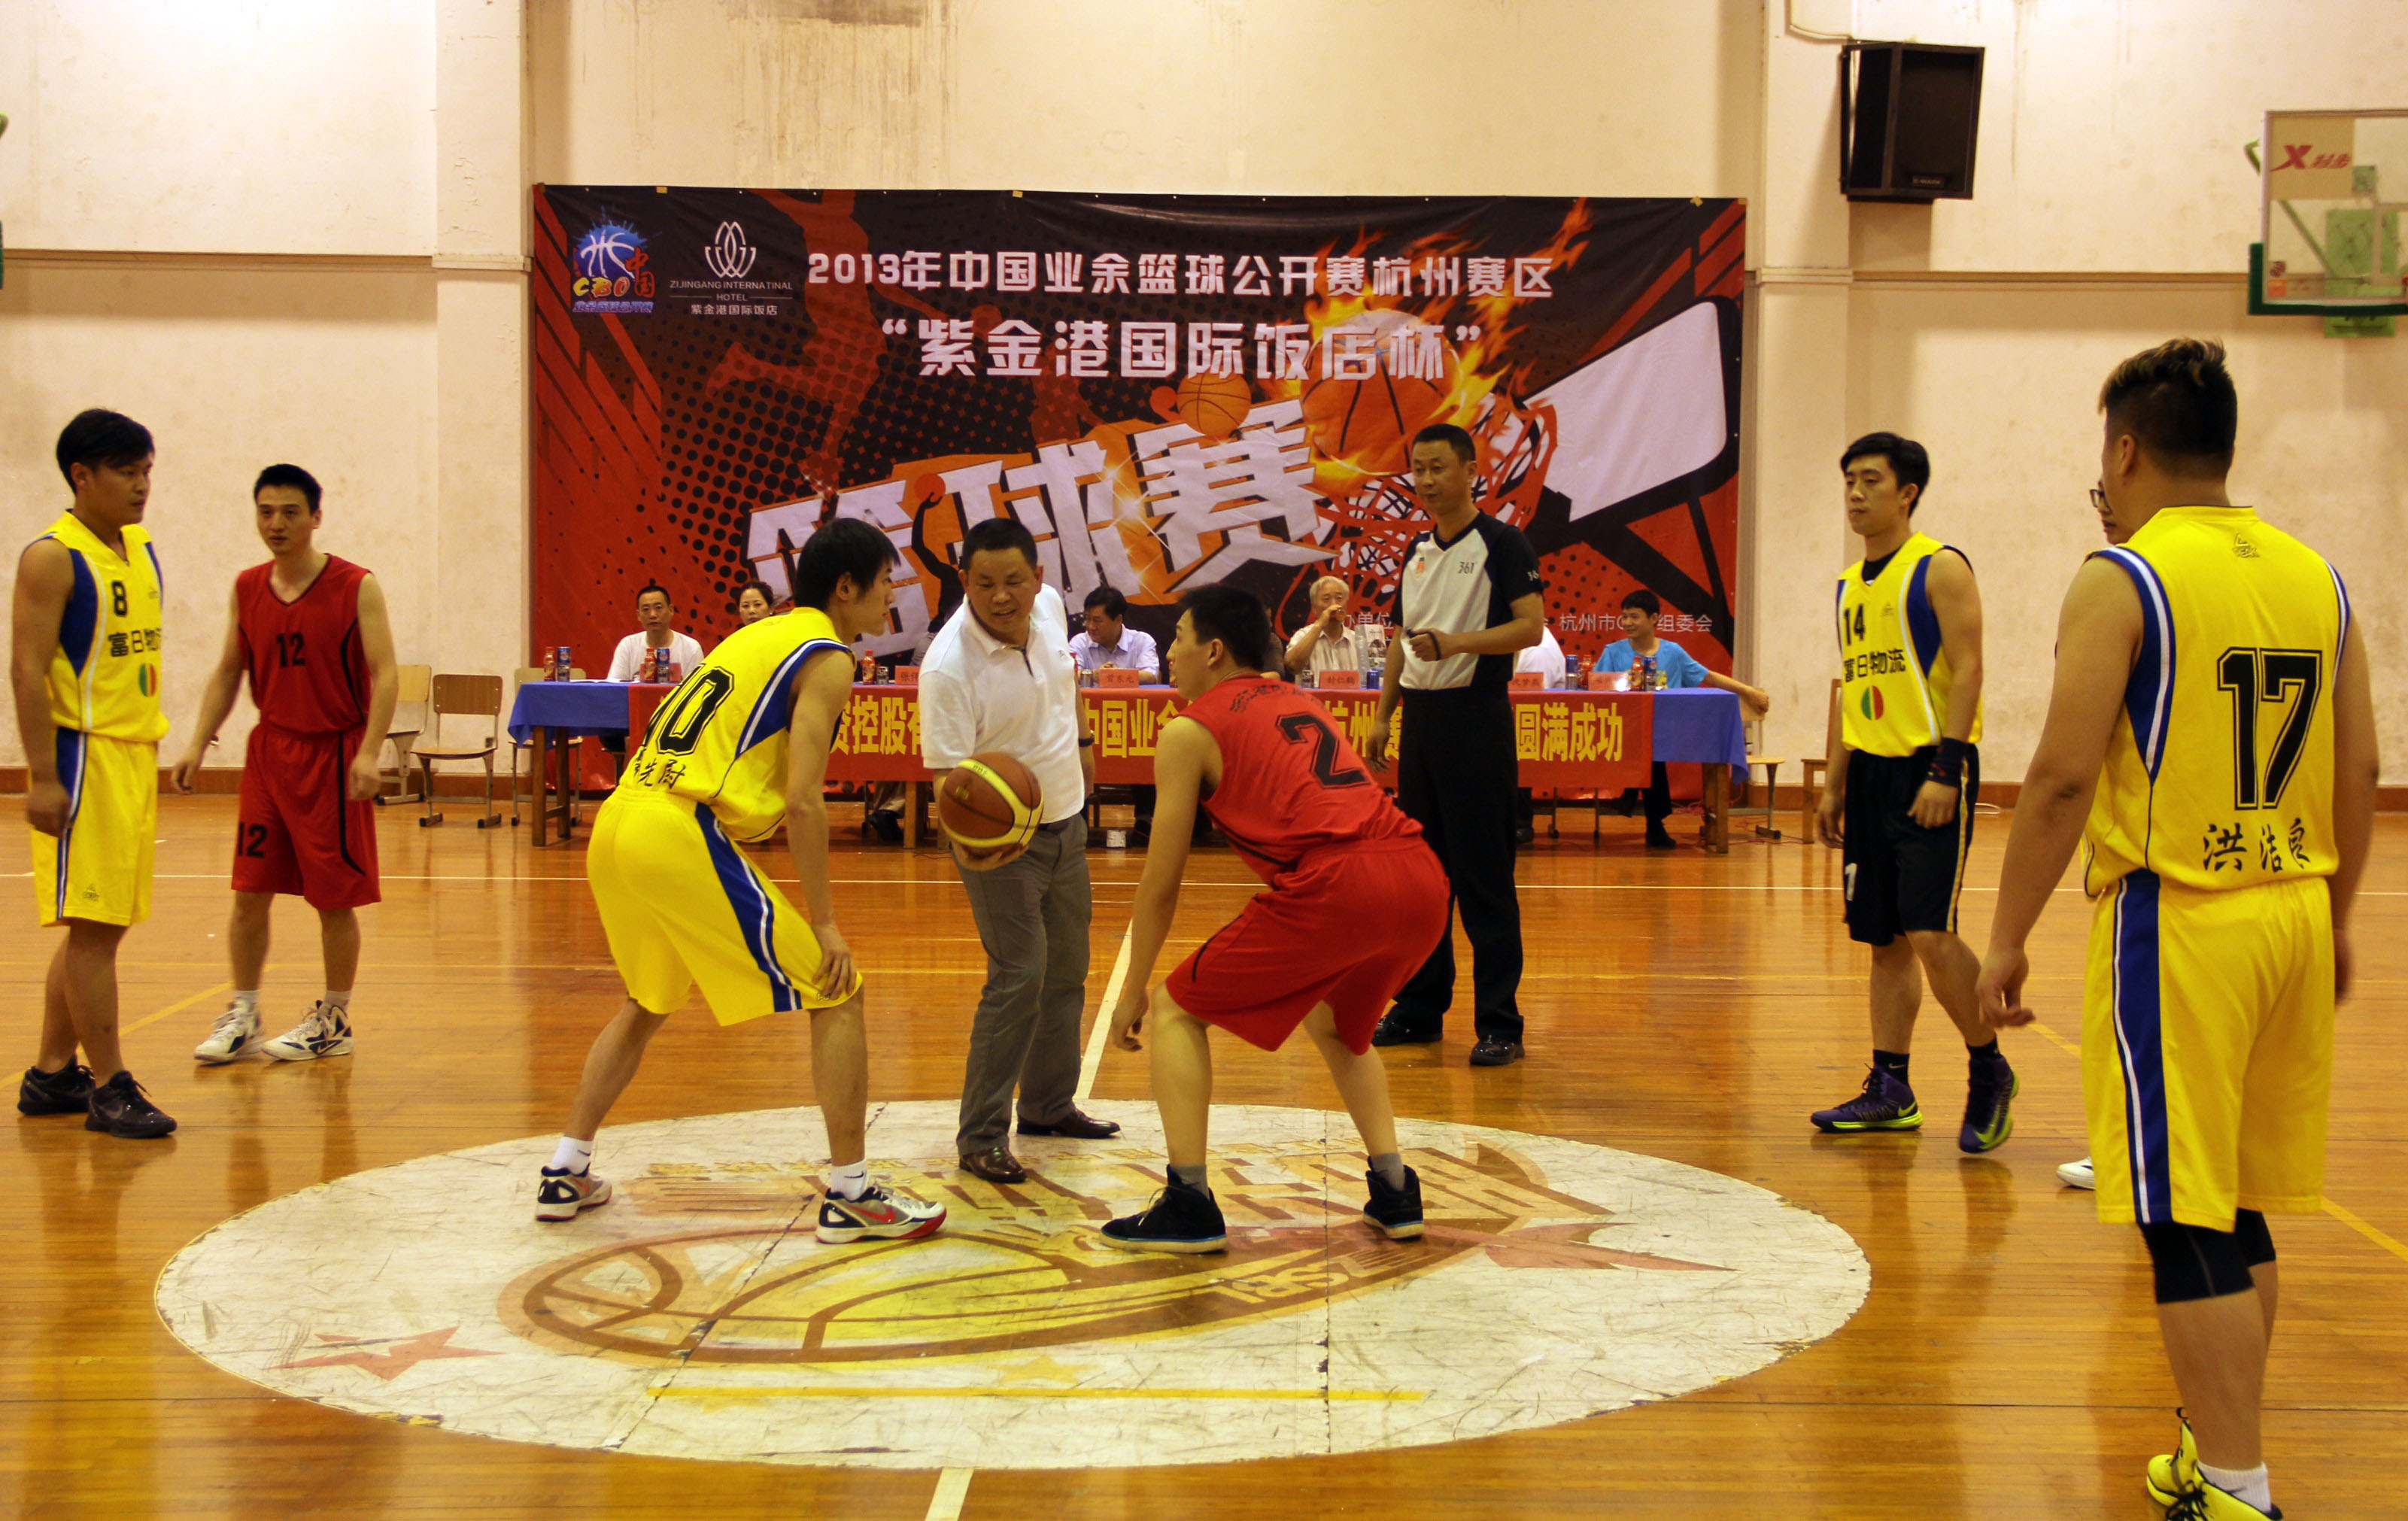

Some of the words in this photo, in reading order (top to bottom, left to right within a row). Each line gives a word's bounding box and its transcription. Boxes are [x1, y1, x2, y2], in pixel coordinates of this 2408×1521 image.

[572, 277, 630, 298] CBO
[670, 280, 721, 290] ZIJINGANG
[809, 250, 1553, 297] 2013年中国业余篮球公开赛杭州赛区
[691, 304, 778, 316] 紫金港国际饭店
[716, 293, 749, 302] HOTEL
[111, 580, 128, 617] 8
[1845, 603, 1865, 646] 14
[276, 633, 305, 667] 12
[1845, 648, 1906, 682] 富日物流
[1515, 702, 1623, 762] 圆满成功
[2217, 646, 2323, 811] 17
[1275, 713, 1377, 791] 2
[237, 824, 266, 858] 12
